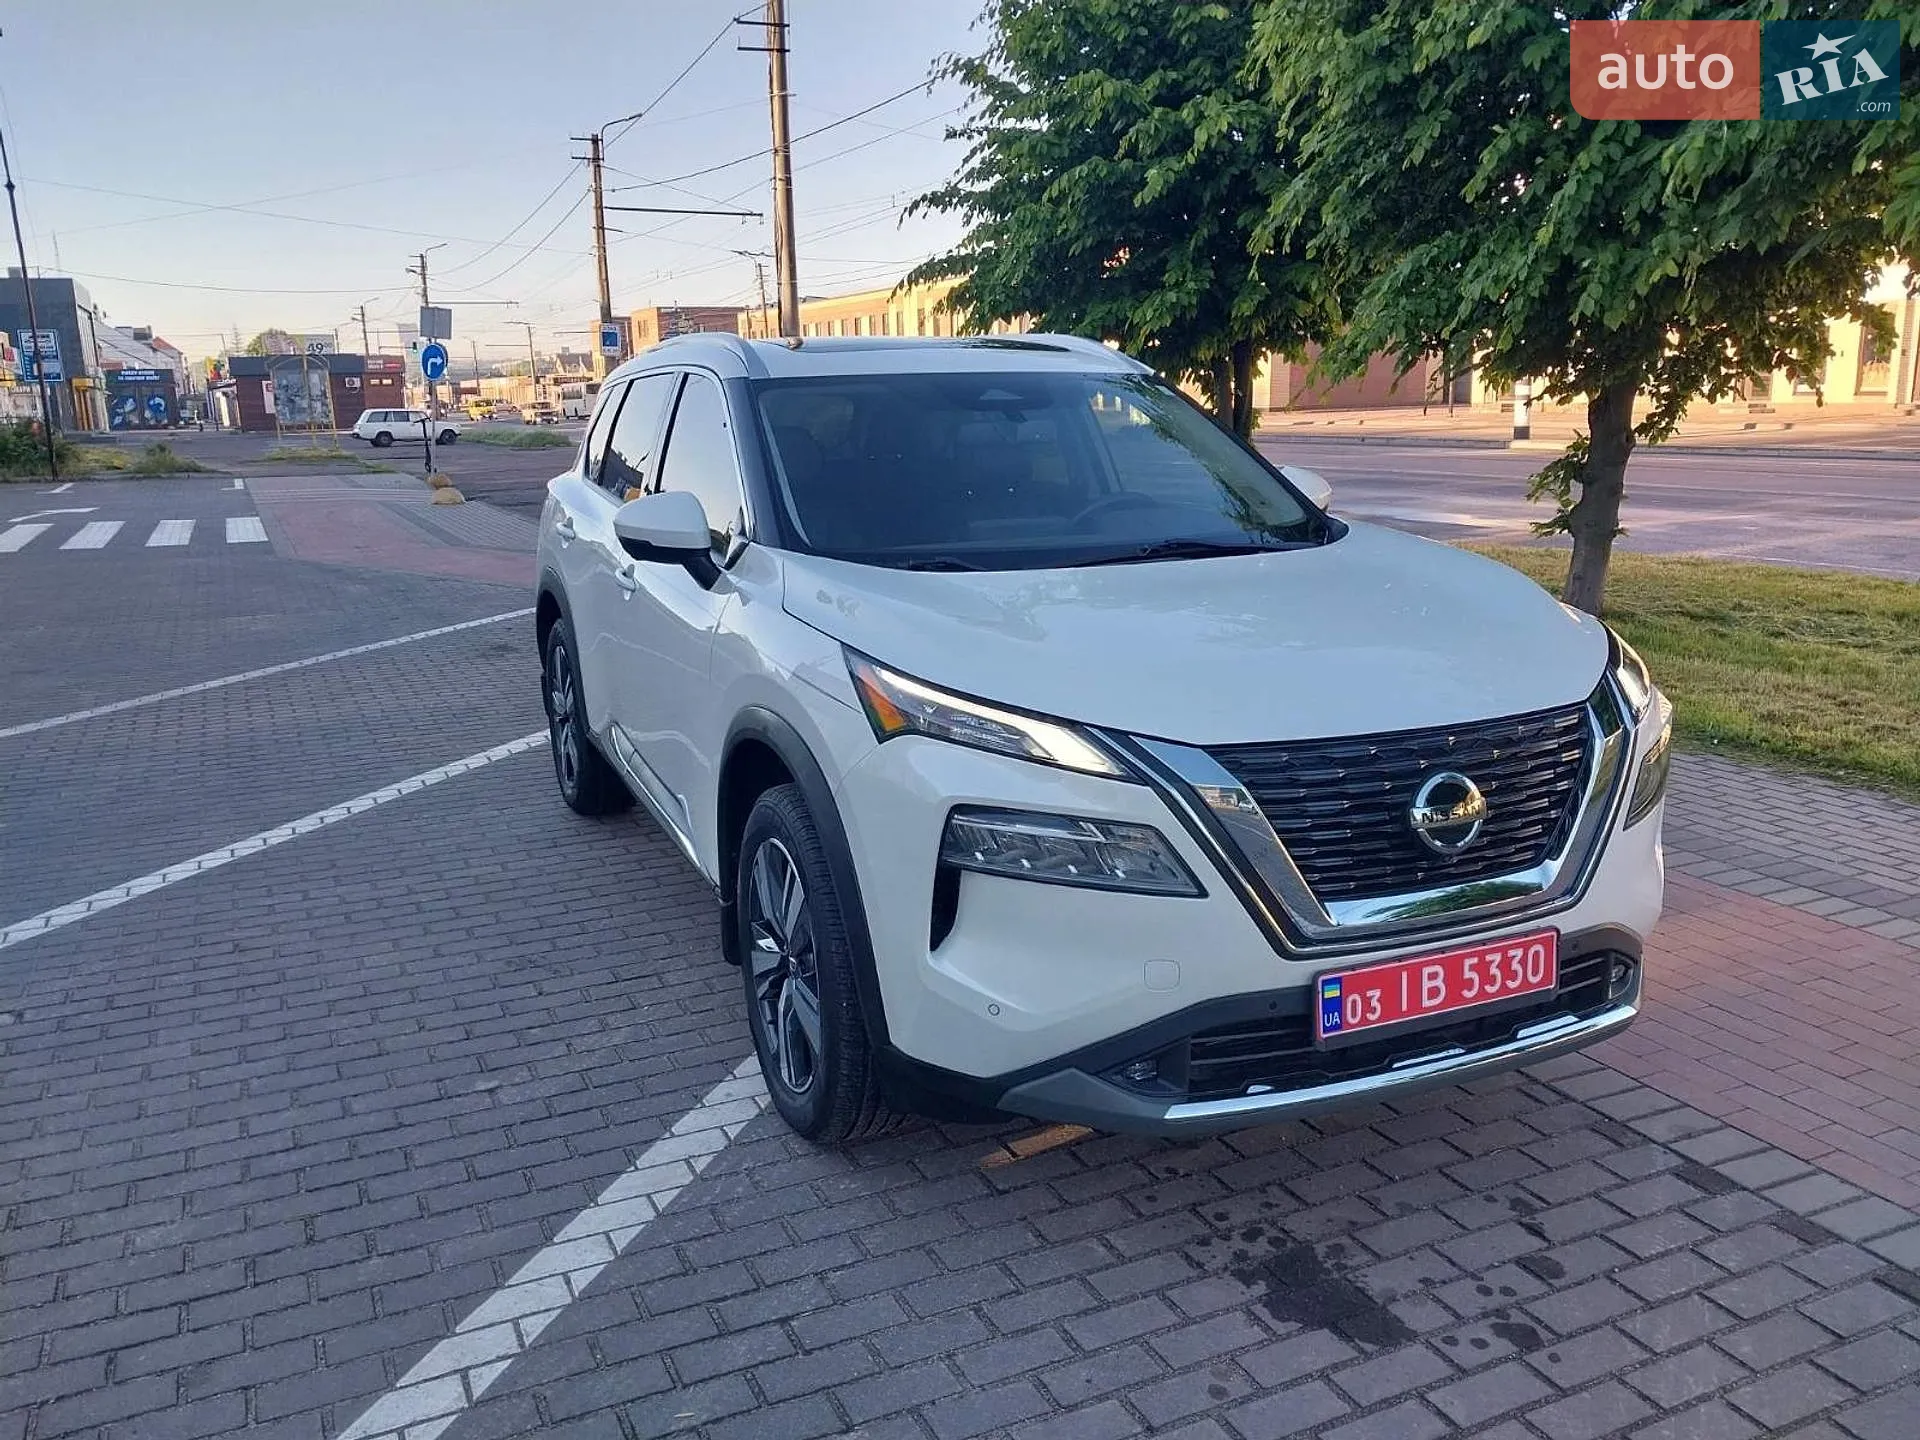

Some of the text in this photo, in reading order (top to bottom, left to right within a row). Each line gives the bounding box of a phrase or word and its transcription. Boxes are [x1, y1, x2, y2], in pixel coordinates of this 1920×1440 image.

[1421, 802, 1482, 823] NISSAN
[1345, 943, 1545, 1025] 03 IB 5330
[1324, 1011, 1341, 1028] UA
